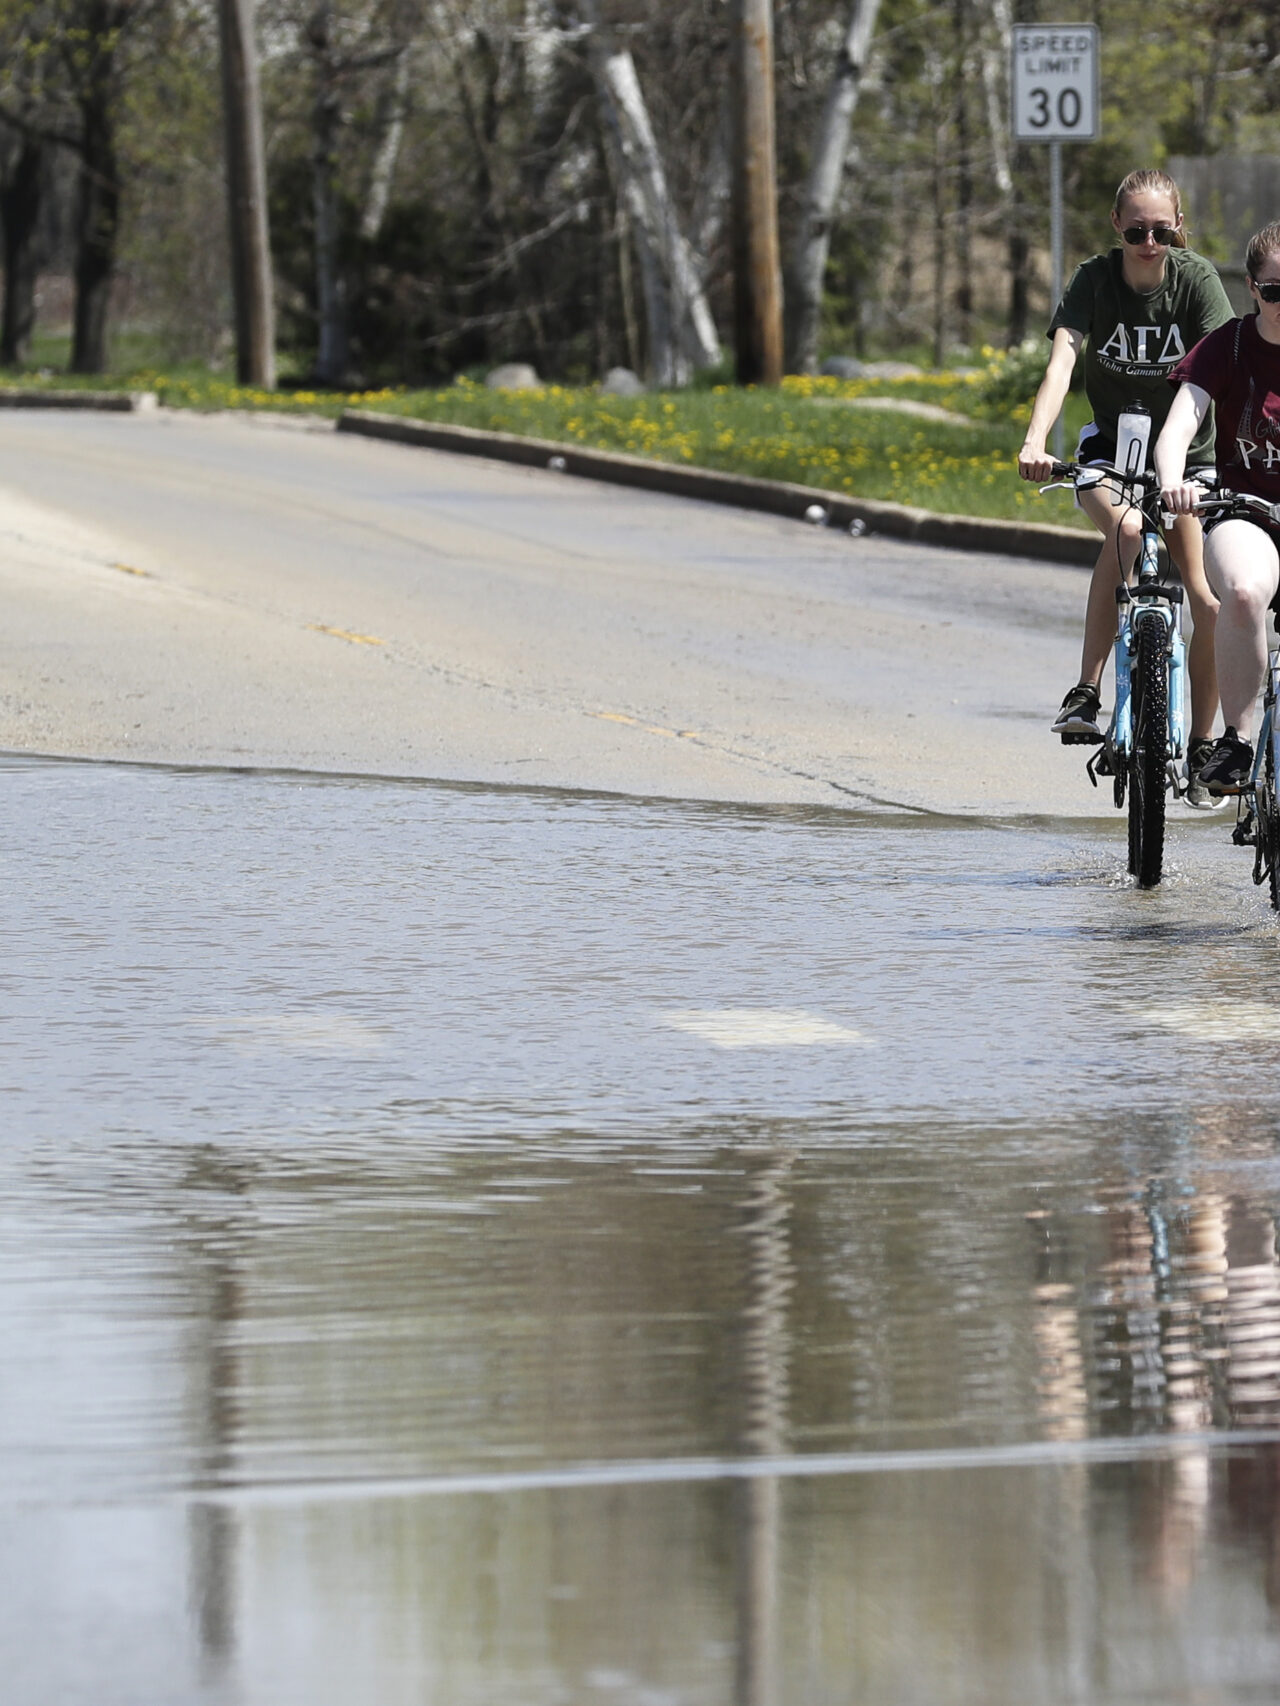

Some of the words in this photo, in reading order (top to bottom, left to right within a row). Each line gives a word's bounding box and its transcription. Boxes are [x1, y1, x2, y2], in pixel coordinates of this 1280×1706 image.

[1020, 36, 1088, 52] SPEED
[1025, 57, 1082, 73] LIMIT
[1029, 87, 1082, 128] 30
[1126, 365, 1163, 377] Gamma
